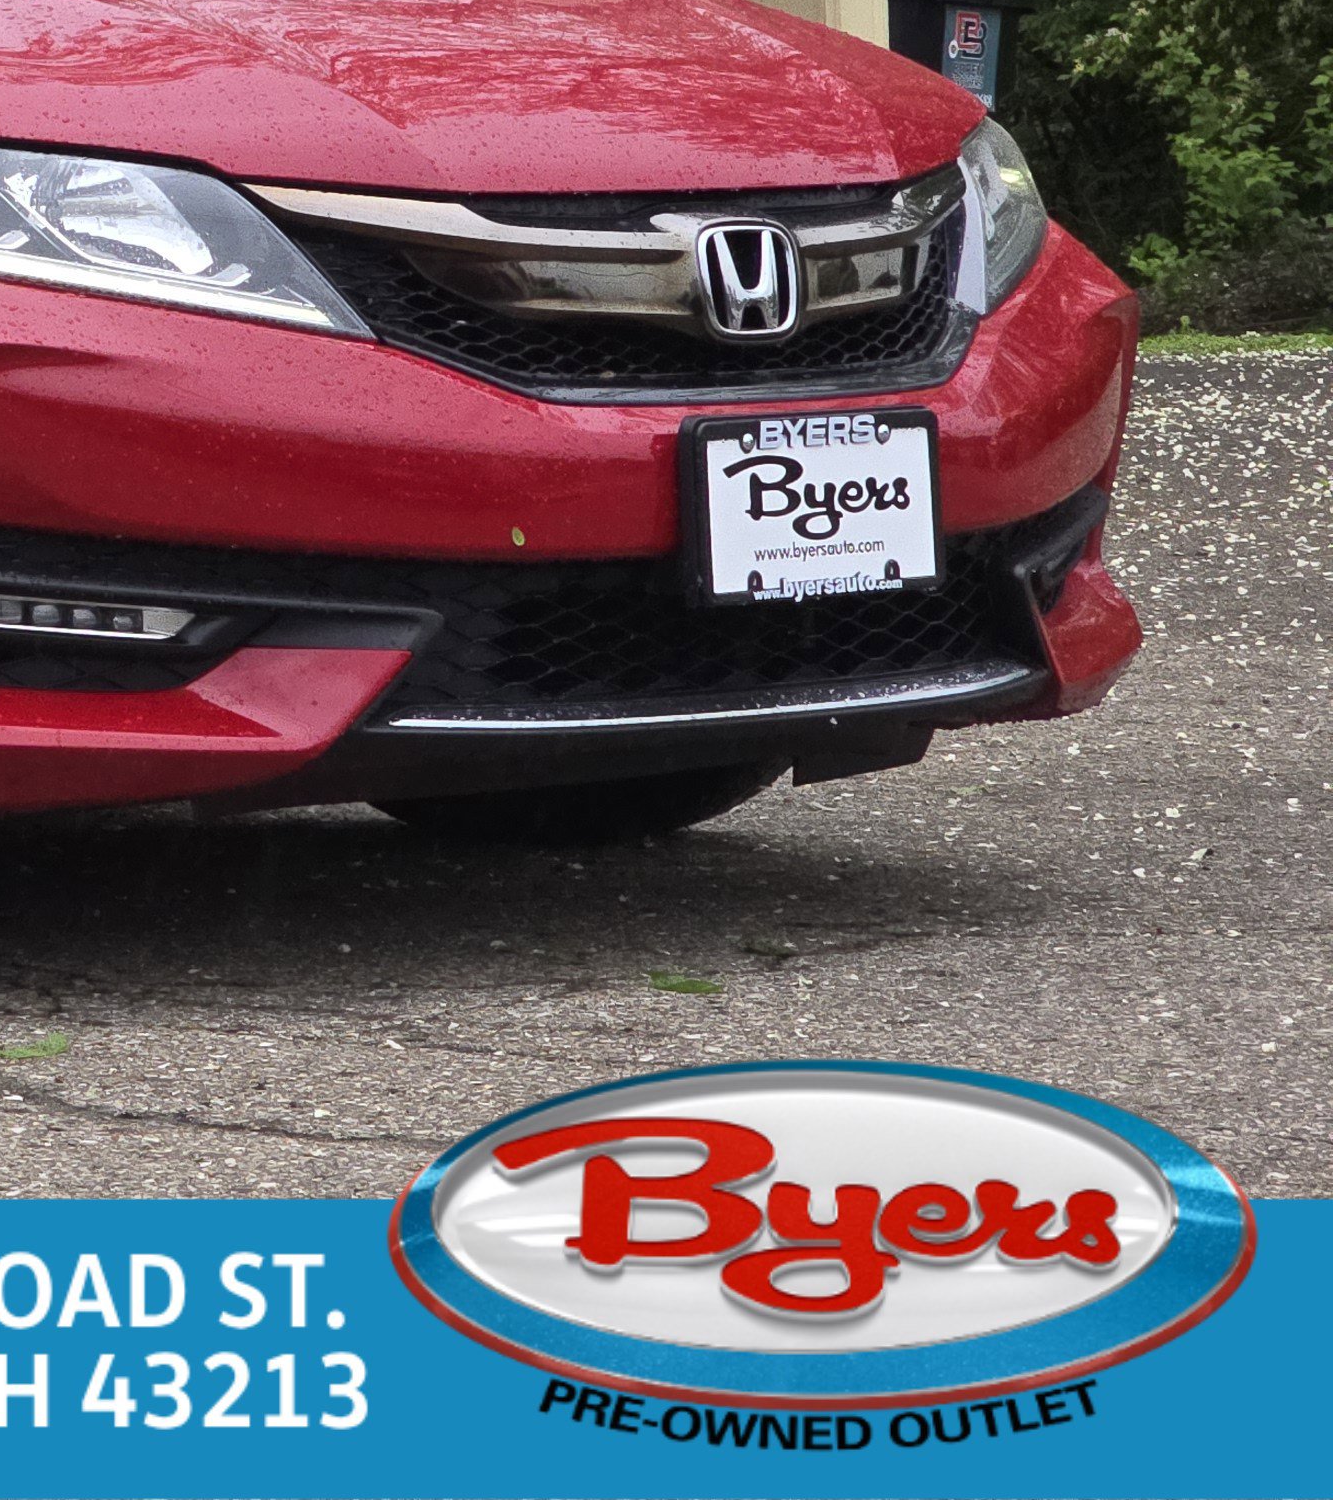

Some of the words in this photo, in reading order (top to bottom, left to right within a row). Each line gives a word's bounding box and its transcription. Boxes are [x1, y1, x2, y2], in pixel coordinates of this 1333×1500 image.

[758, 414, 876, 450] BYERS
[721, 454, 911, 541] Byers
[753, 539, 886, 563] www.byersauto.com
[752, 571, 904, 603] www.byersauto.com
